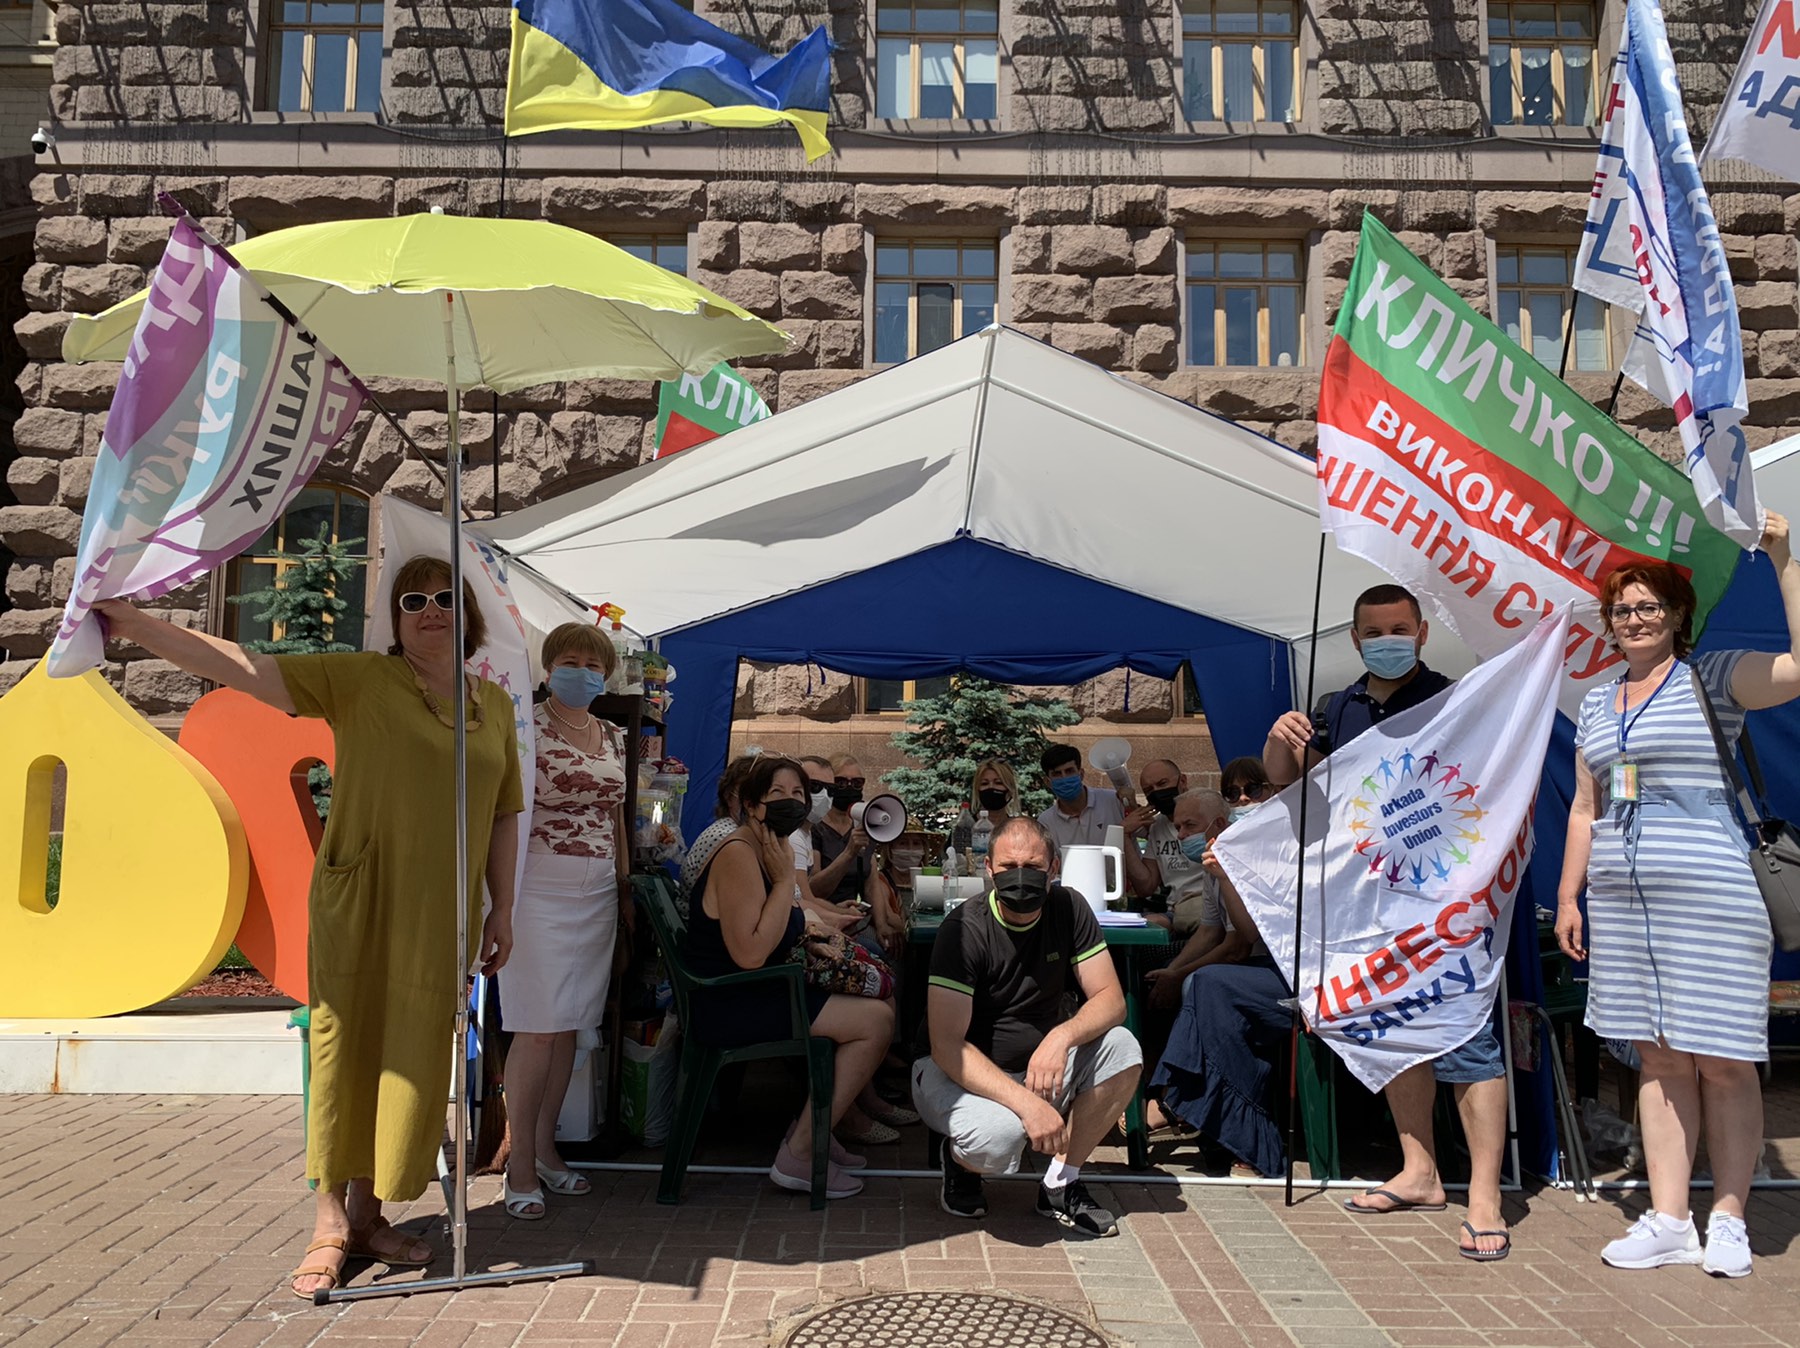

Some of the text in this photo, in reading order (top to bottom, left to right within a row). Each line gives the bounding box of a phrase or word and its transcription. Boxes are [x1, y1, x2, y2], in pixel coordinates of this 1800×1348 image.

[1354, 259, 1615, 495] КЛИЧКО
[1624, 479, 1696, 553] !!!
[1317, 449, 1496, 598] ШЕННЯ
[1380, 788, 1426, 818] Arkada
[1382, 802, 1443, 839] Investors
[1402, 824, 1443, 850] Union
[1340, 954, 1476, 1046] БАНКУ
